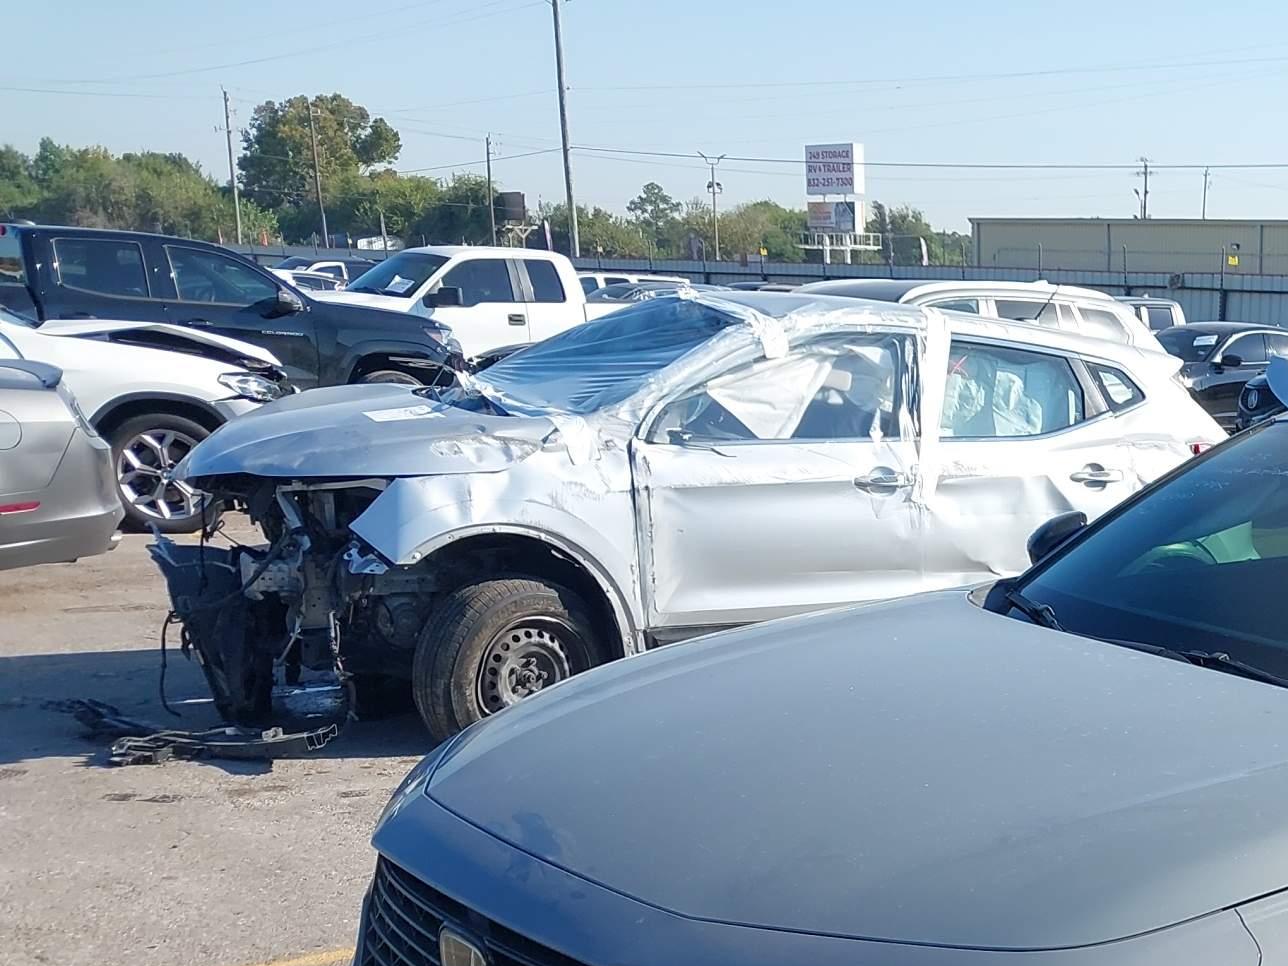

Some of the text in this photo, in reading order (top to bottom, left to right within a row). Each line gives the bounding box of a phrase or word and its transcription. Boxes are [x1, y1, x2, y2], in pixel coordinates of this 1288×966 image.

[821, 150, 849, 160] STORAGE
[808, 163, 817, 173] RV
[823, 162, 851, 173] TRAILER
